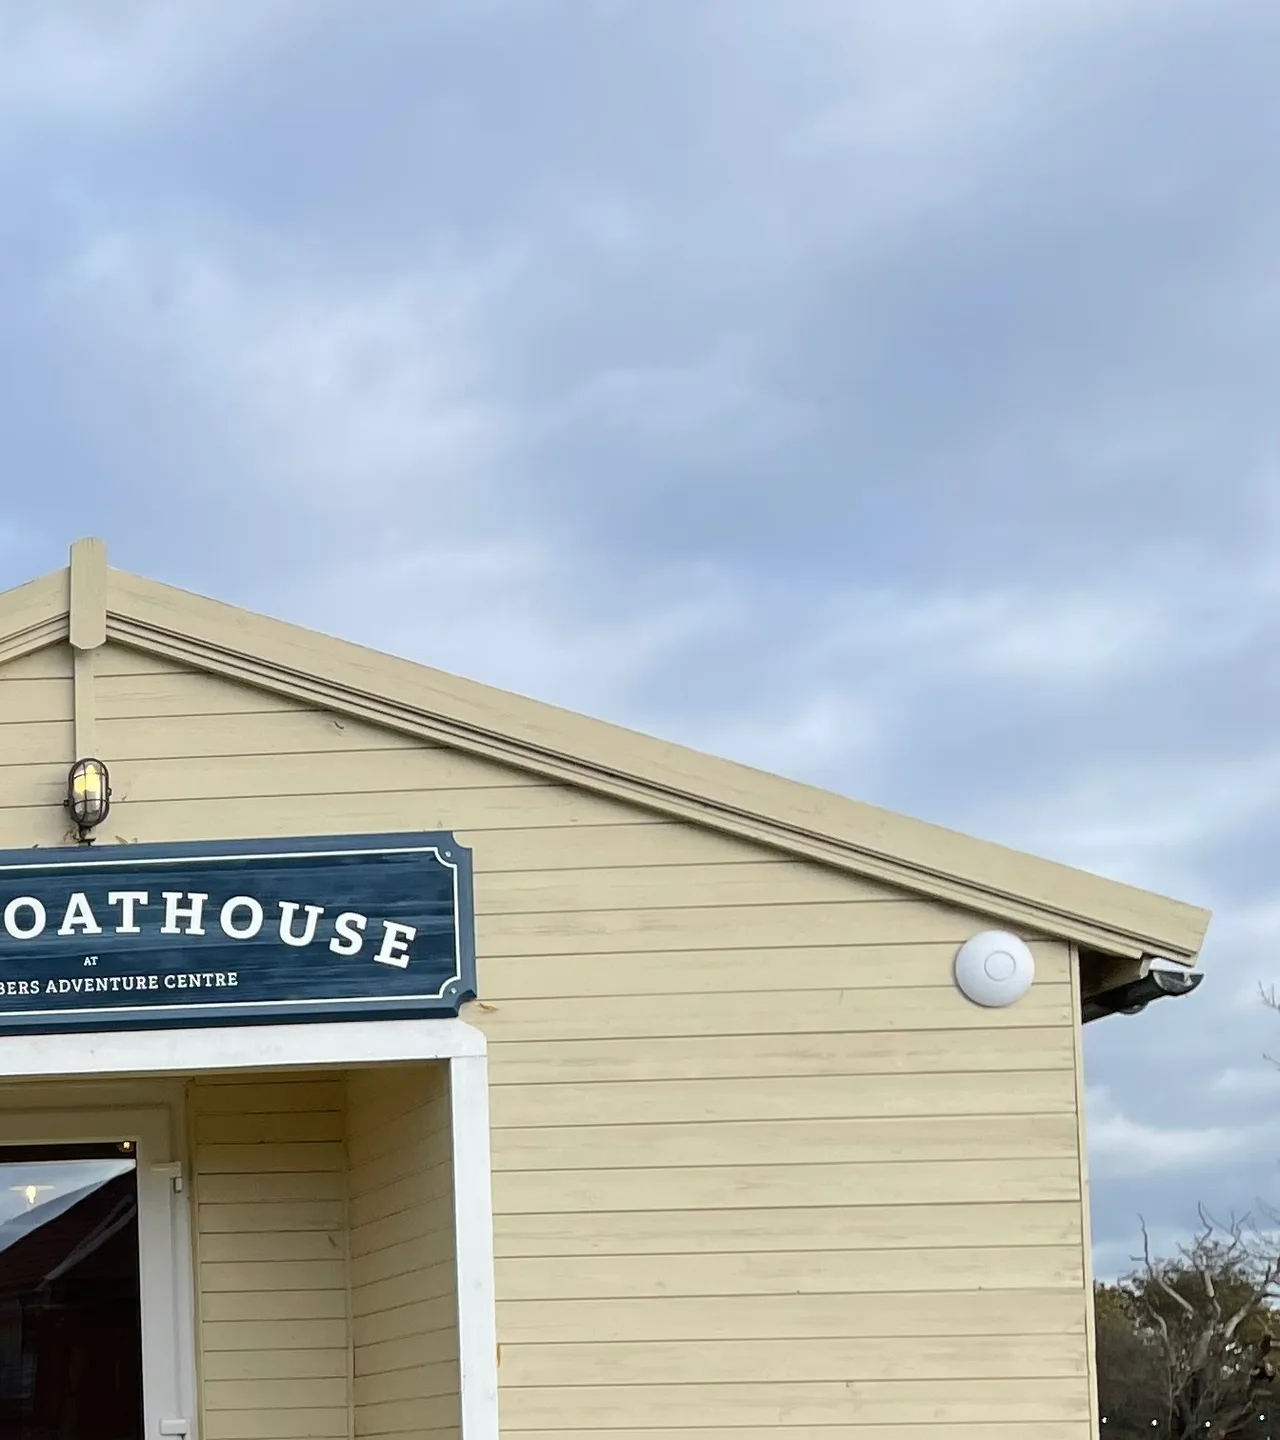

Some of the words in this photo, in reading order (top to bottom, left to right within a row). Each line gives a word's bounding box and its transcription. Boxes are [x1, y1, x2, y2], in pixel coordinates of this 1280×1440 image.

[83, 956, 98, 966] AT
[45, 975, 159, 994] ADVENTURE
[164, 972, 239, 989] CENTRE
